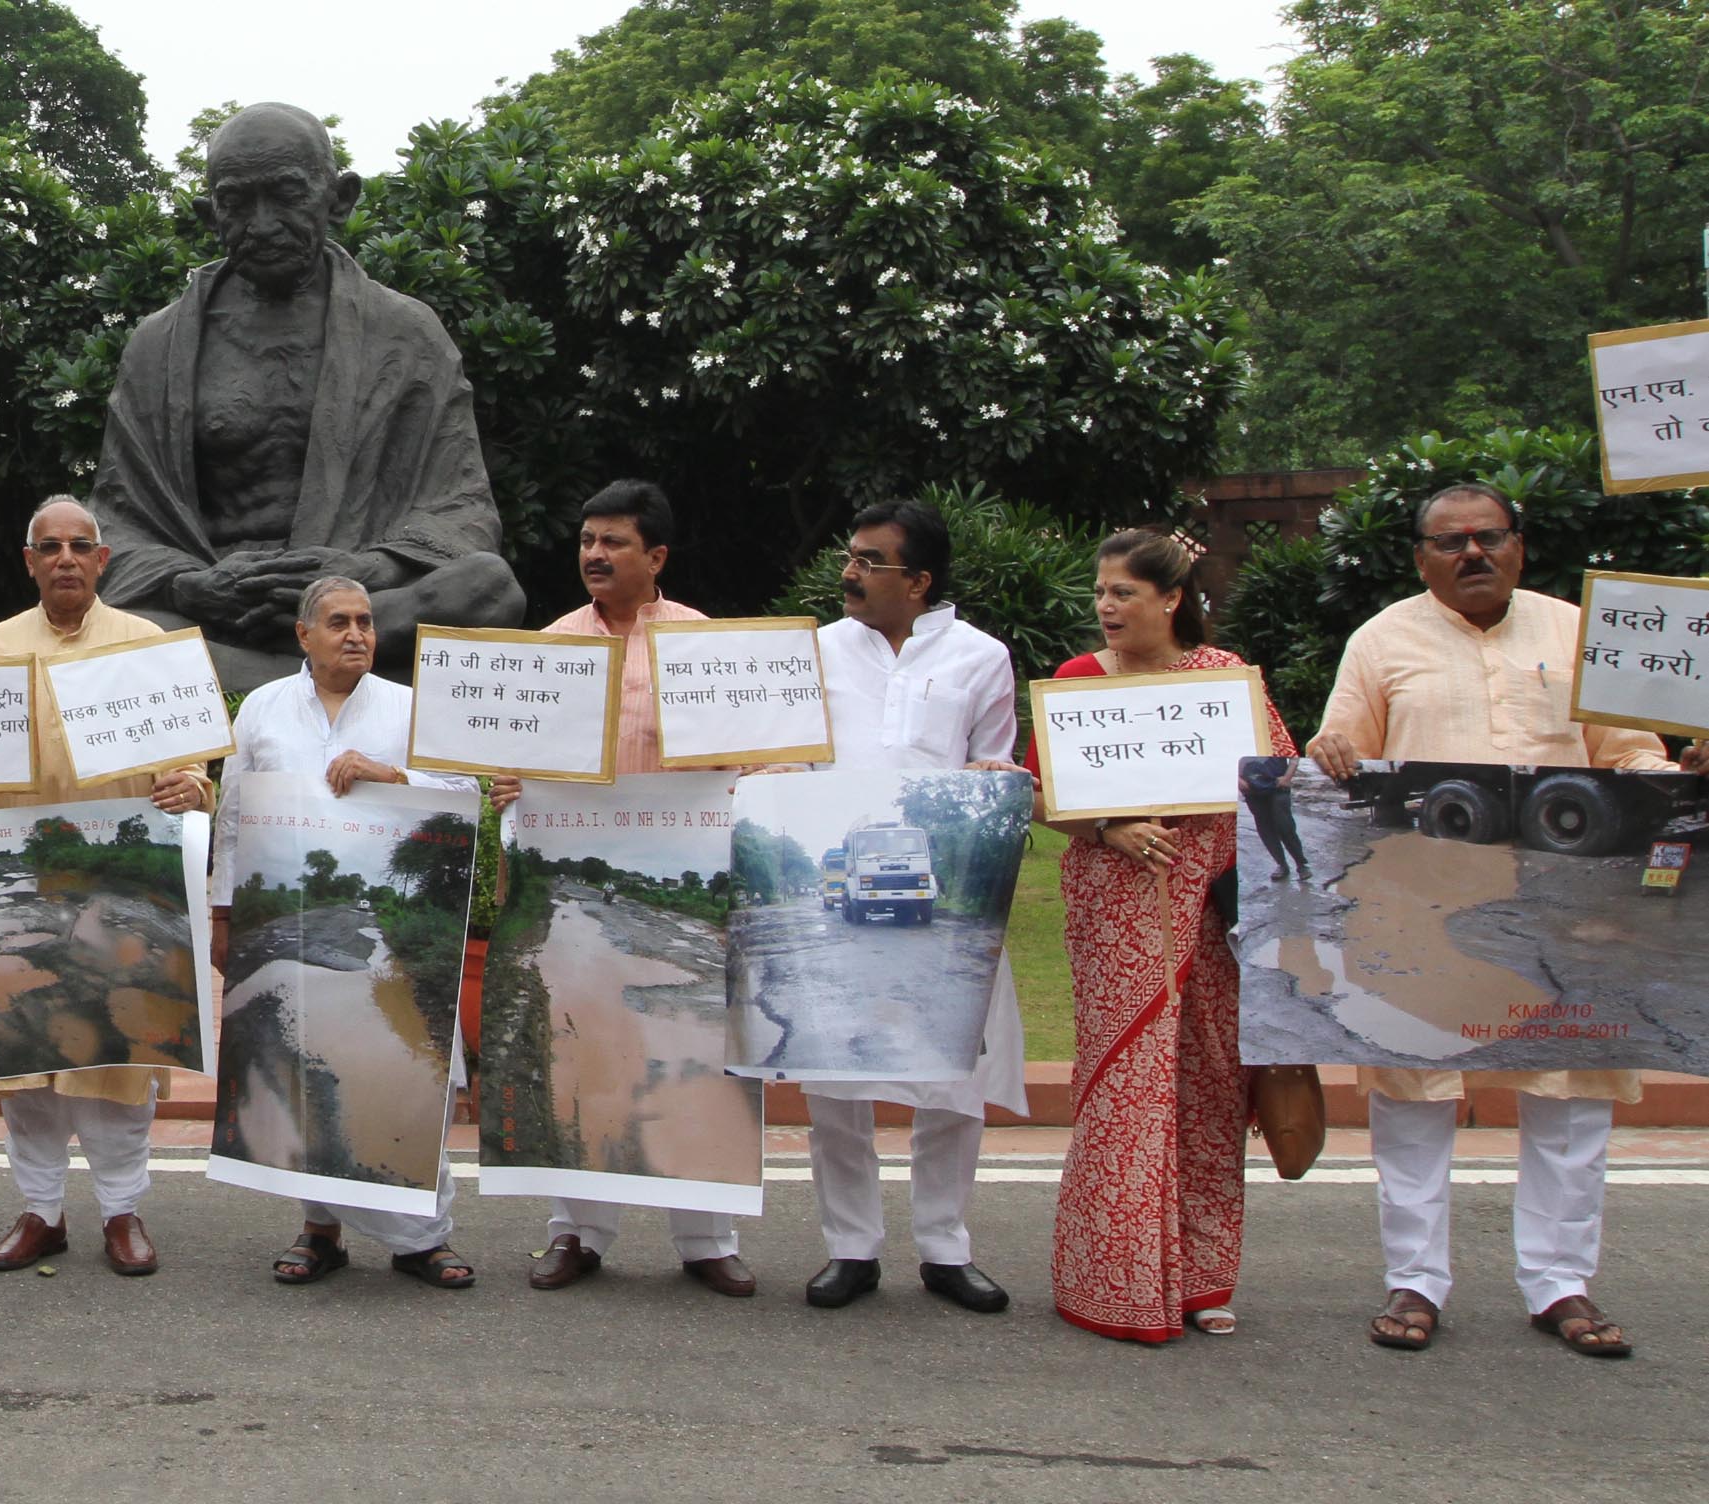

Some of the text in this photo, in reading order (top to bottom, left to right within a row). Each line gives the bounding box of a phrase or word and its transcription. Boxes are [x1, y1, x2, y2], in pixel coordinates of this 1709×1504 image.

[1599, 379, 1694, 409] एन.एच.
[1652, 414, 1683, 440] तो
[1600, 605, 1709, 636] बदले क
[420, 650, 596, 677] मंत्री जी होश में आओ
[664, 655, 813, 677] मध्य प्रदेश के राष्ट्रीय
[1583, 641, 1700, 680] बंद करो,
[60, 704, 98, 722] सड़क
[104, 696, 140, 718] सुधार
[147, 691, 166, 705] का
[172, 683, 199, 700] पैसा
[451, 680, 561, 704] होश में आकर
[660, 685, 716, 705] राजमार्ग
[1197, 700, 1230, 718] का
[84, 707, 212, 746] वरना कुर्सी छोड़ दो
[467, 714, 541, 734] काम करो
[1079, 732, 1206, 768] सुधार करो
[21, 826, 36, 836] 59
[343, 822, 360, 833] ON
[369, 825, 385, 836] 59
[392, 828, 401, 838] A
[522, 813, 537, 829] OF
[545, 812, 605, 828] N.H.A.I.
[614, 812, 631, 827] ON
[637, 812, 654, 827] NH
[661, 812, 676, 827] 59
[684, 812, 693, 827] A
[1508, 1003, 1592, 1018] KM30/10
[1461, 1023, 1629, 1040] NH 69/09-08-2011
